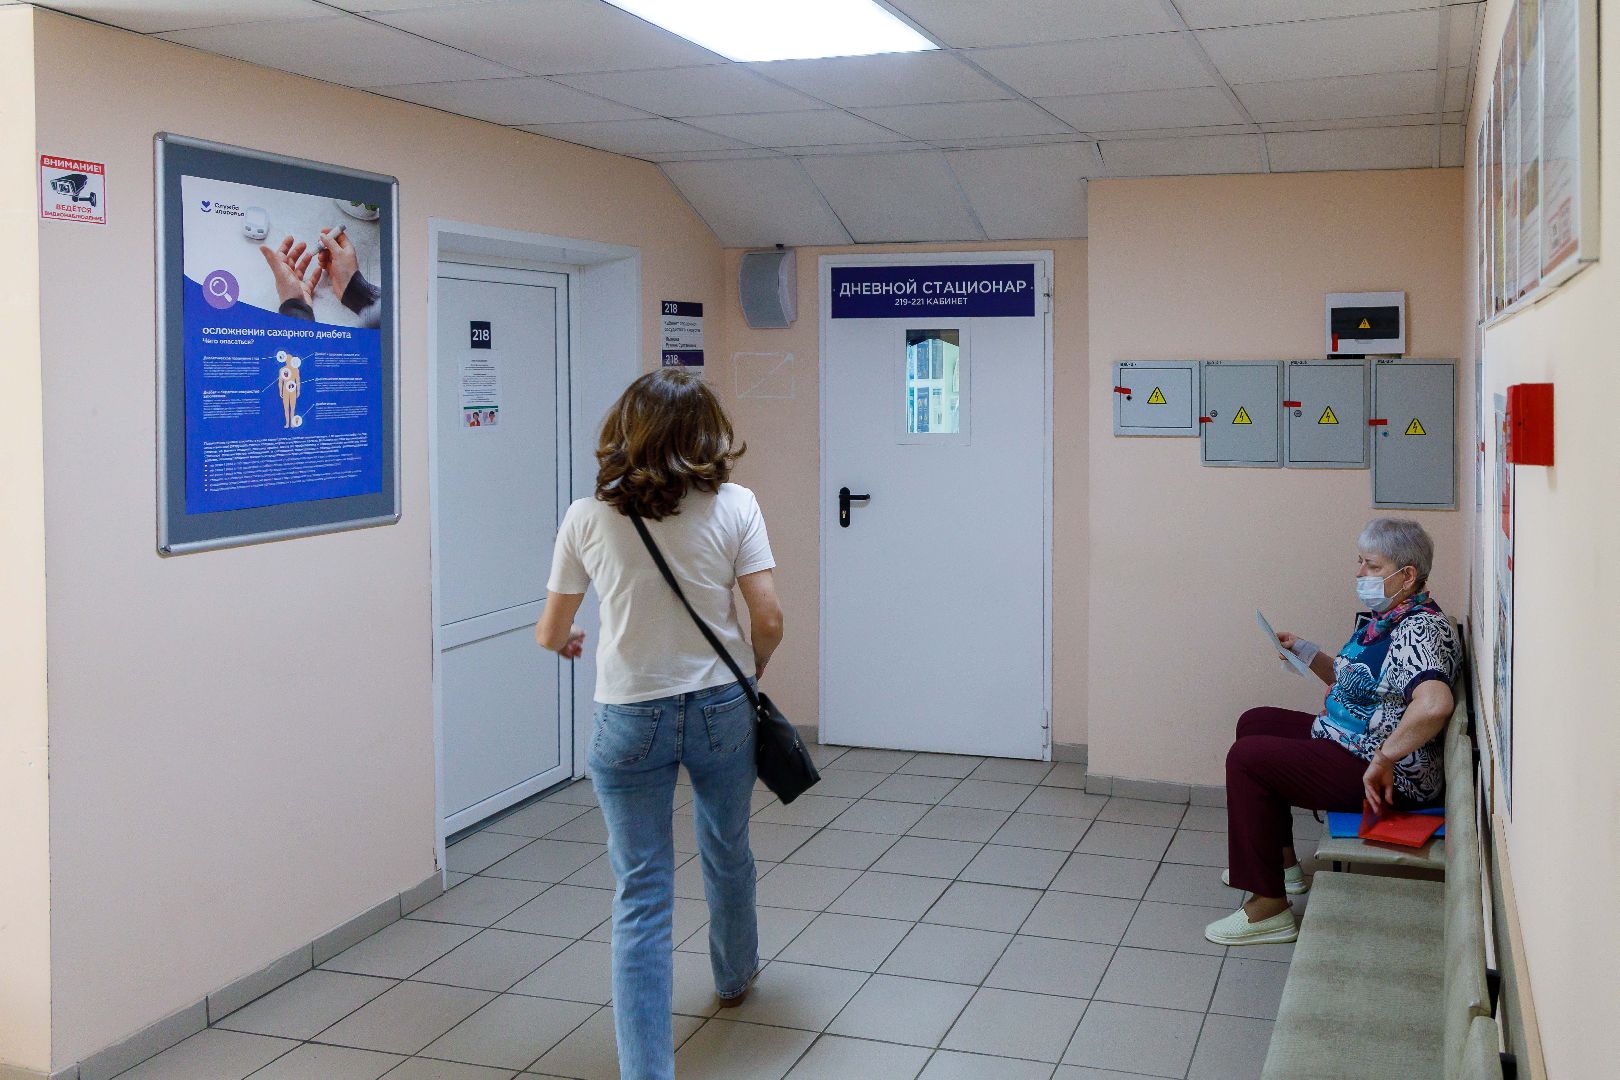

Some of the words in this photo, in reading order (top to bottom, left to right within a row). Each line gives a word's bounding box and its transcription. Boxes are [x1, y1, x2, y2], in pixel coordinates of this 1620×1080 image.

[43, 158, 102, 173] ВНИМАНИЕ!
[839, 278, 917, 298] ДНЕВНОЙ
[922, 279, 1027, 296] СТАЦИОНАР
[894, 297, 925, 306] 219-221
[926, 297, 968, 305] КАБИНЕТ
[664, 303, 678, 314] 218
[267, 328, 314, 339] сахарного
[316, 329, 352, 340] диабета
[472, 329, 490, 341] 218
[665, 354, 679, 365] 218
